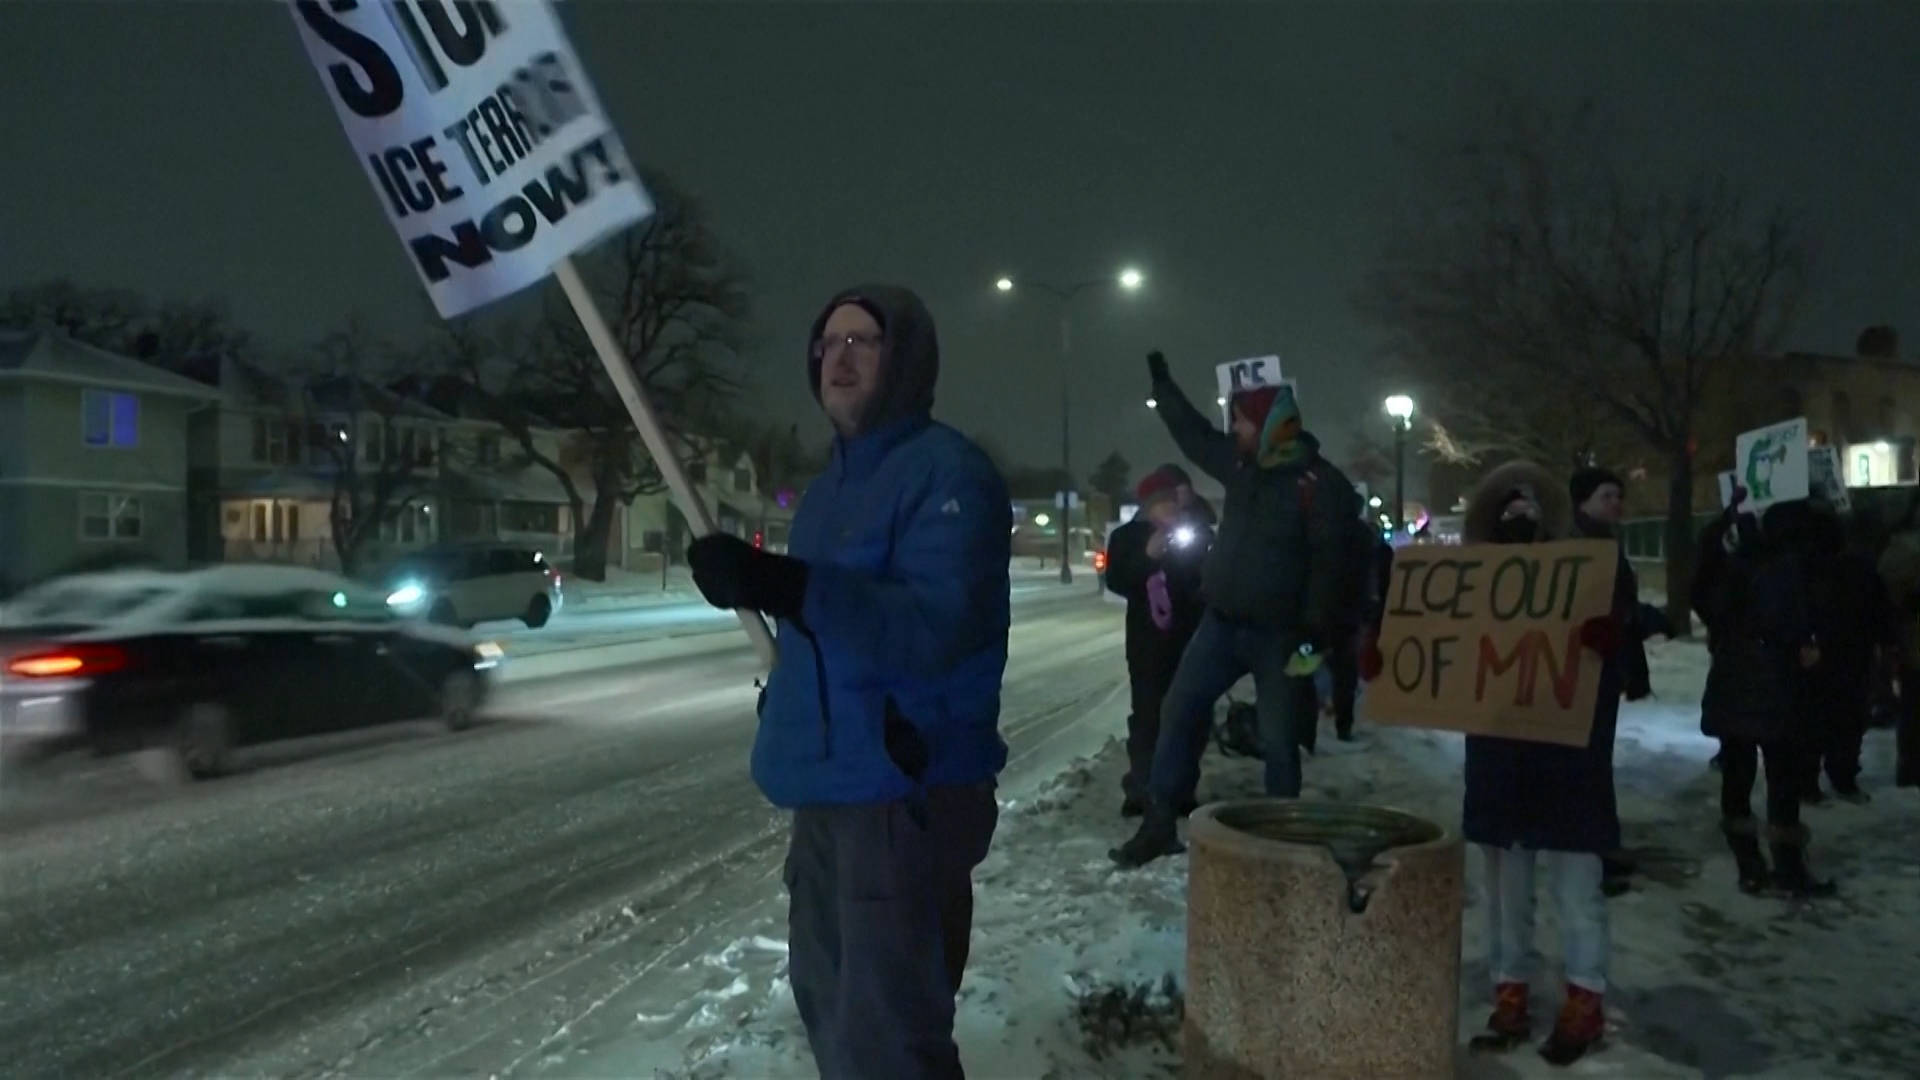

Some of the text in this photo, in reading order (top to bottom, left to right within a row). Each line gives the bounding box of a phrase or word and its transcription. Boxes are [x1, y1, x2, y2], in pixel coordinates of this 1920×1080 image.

[299, 0, 508, 118] ST
[369, 51, 590, 217] ICE TERR
[410, 137, 621, 282] NOW!
[1389, 556, 1592, 620] ICE OUT
[1393, 626, 1583, 709] OF MN
